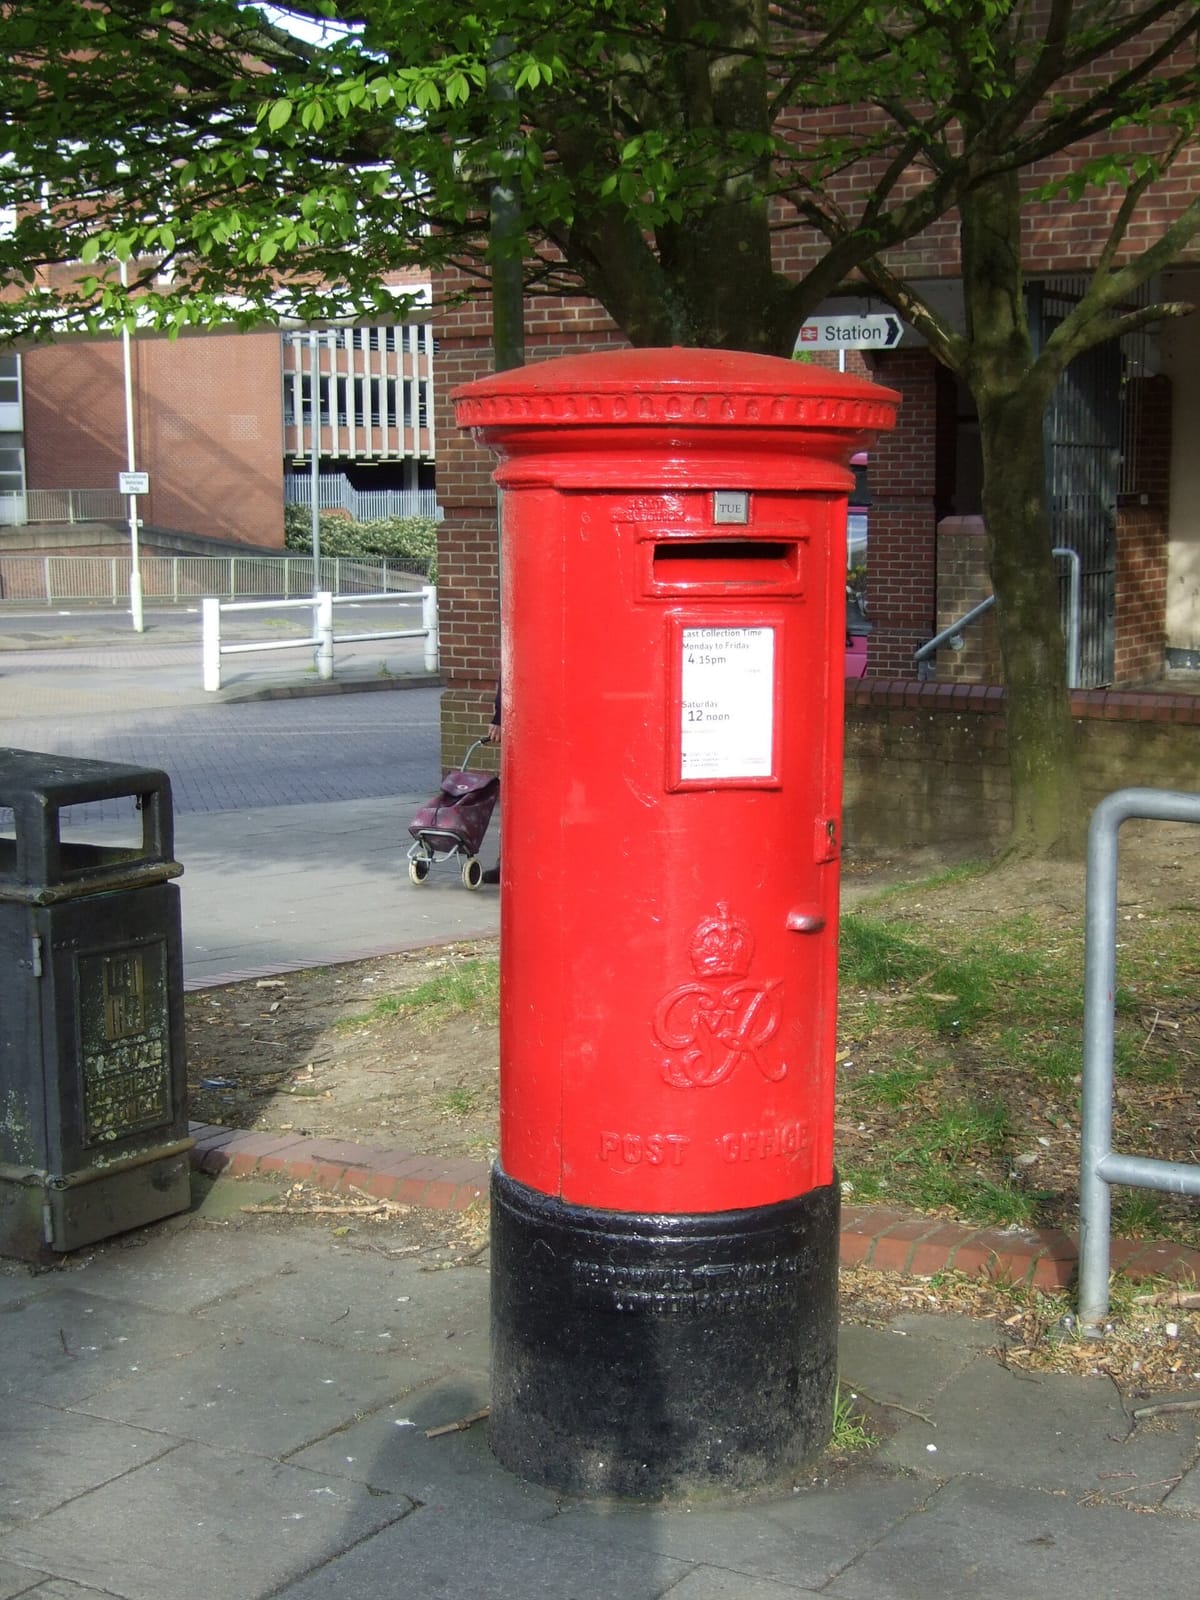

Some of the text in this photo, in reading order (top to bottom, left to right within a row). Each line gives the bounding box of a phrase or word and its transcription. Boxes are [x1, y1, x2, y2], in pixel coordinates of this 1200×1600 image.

[825, 325, 881, 341] Station
[719, 503, 742, 514] TUE
[682, 629, 699, 638] Last
[701, 628, 740, 638] Collection
[682, 641, 750, 651] Monday to Friday
[688, 653, 727, 666] 4.15pm
[682, 700, 718, 709] Saturday
[688, 709, 730, 722] 12 noon
[598, 1122, 809, 1166] POST OFFICE
